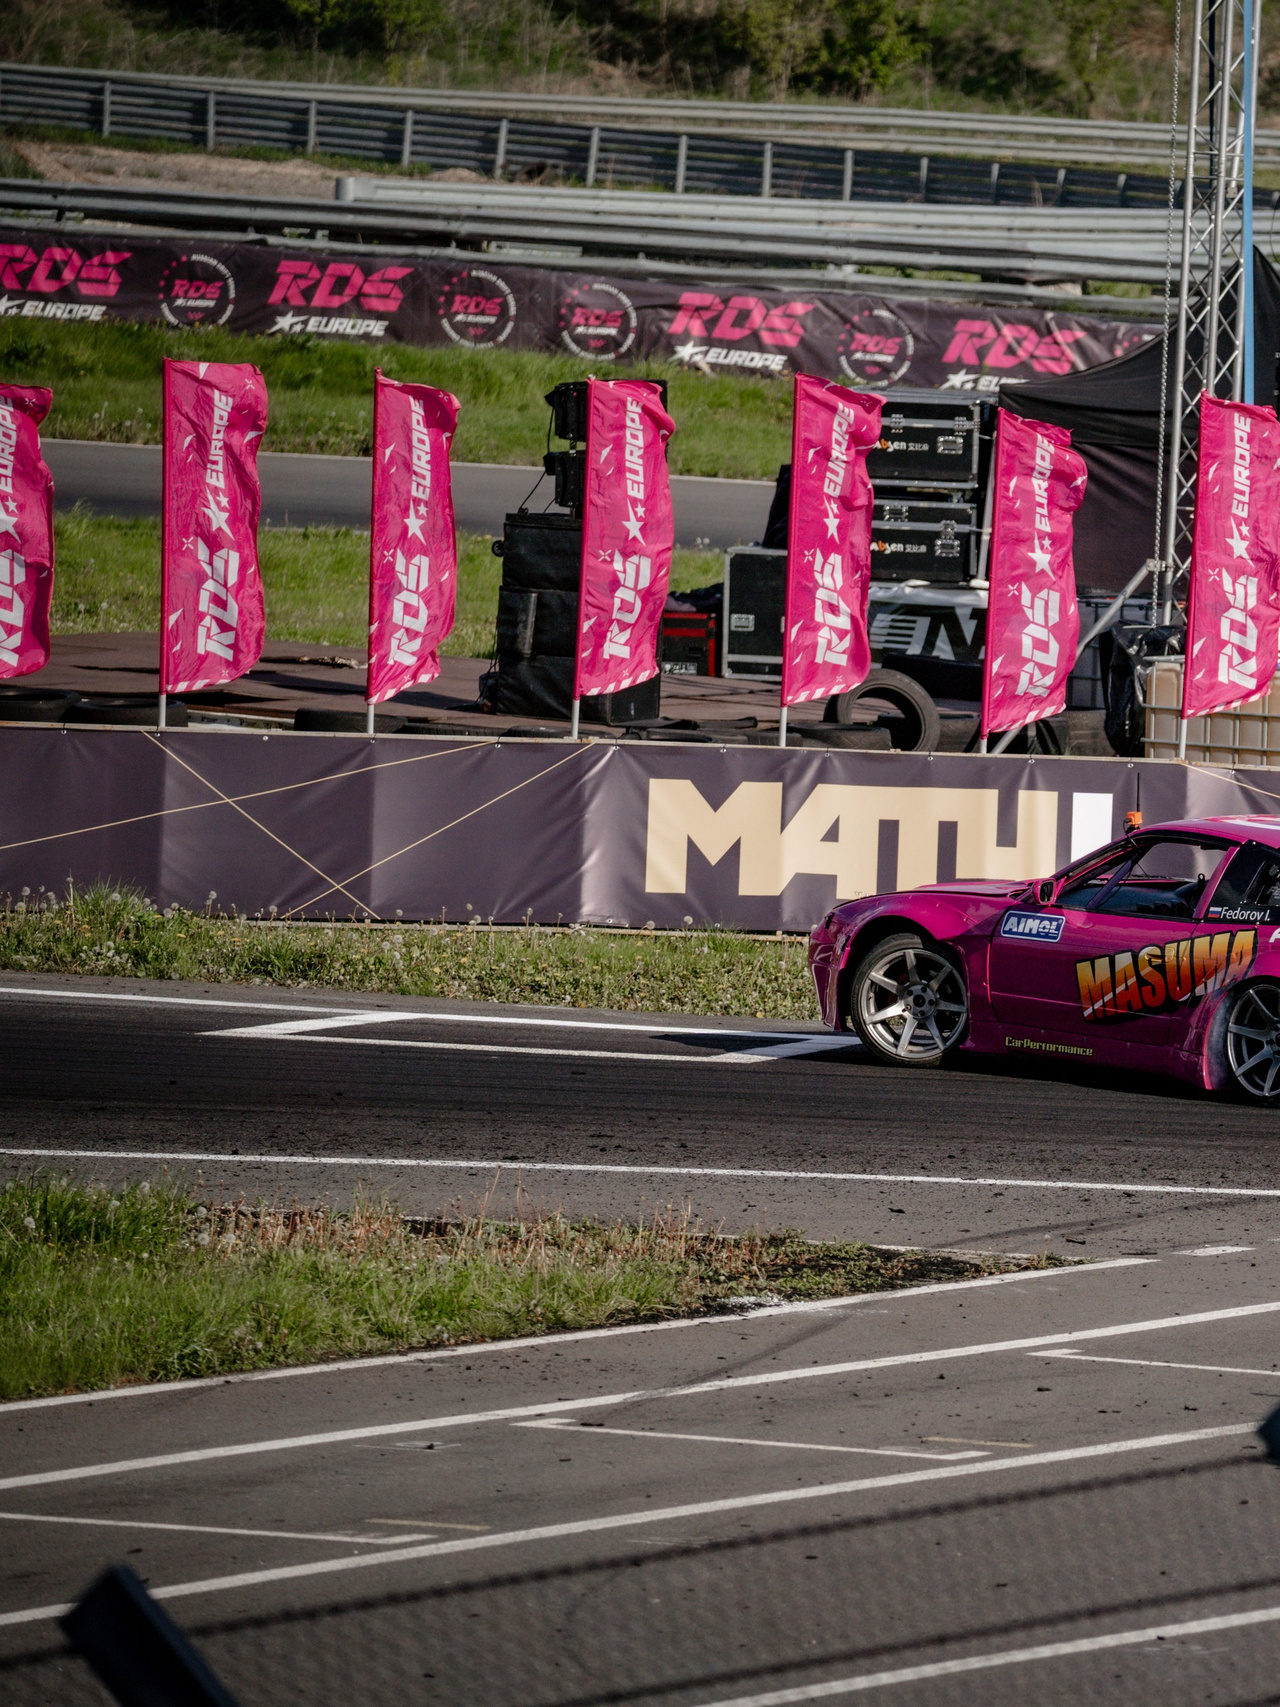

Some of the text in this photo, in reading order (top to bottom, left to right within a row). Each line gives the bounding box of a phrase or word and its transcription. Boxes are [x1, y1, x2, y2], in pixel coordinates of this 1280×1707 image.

[0, 245, 133, 297] RDS
[171, 279, 224, 299] RDS
[267, 260, 415, 312] RDS
[20, 301, 107, 321] EUROPE
[450, 294, 504, 315] RDS
[571, 306, 626, 328] RDS
[668, 292, 817, 347] RDS
[305, 315, 389, 337] EUROPE
[849, 332, 904, 355] RDS
[705, 348, 788, 371] EUROPE
[941, 319, 1088, 376] RDS
[873, 438, 907, 452] Absen
[197, 390, 239, 662] RDS EUROPE
[388, 396, 431, 666] RDS EUROPE
[603, 397, 651, 659] RDS EUROPE
[814, 402, 855, 666] RDS EUROPE
[870, 540, 904, 554] Absen
[1015, 433, 1060, 697] RDS EUROPE
[1218, 413, 1258, 689] RDS EUROPE
[1003, 916, 1059, 936] AIMOL
[1220, 907, 1271, 921] Fedorov I.
[1076, 929, 1257, 1021] MASUMA
